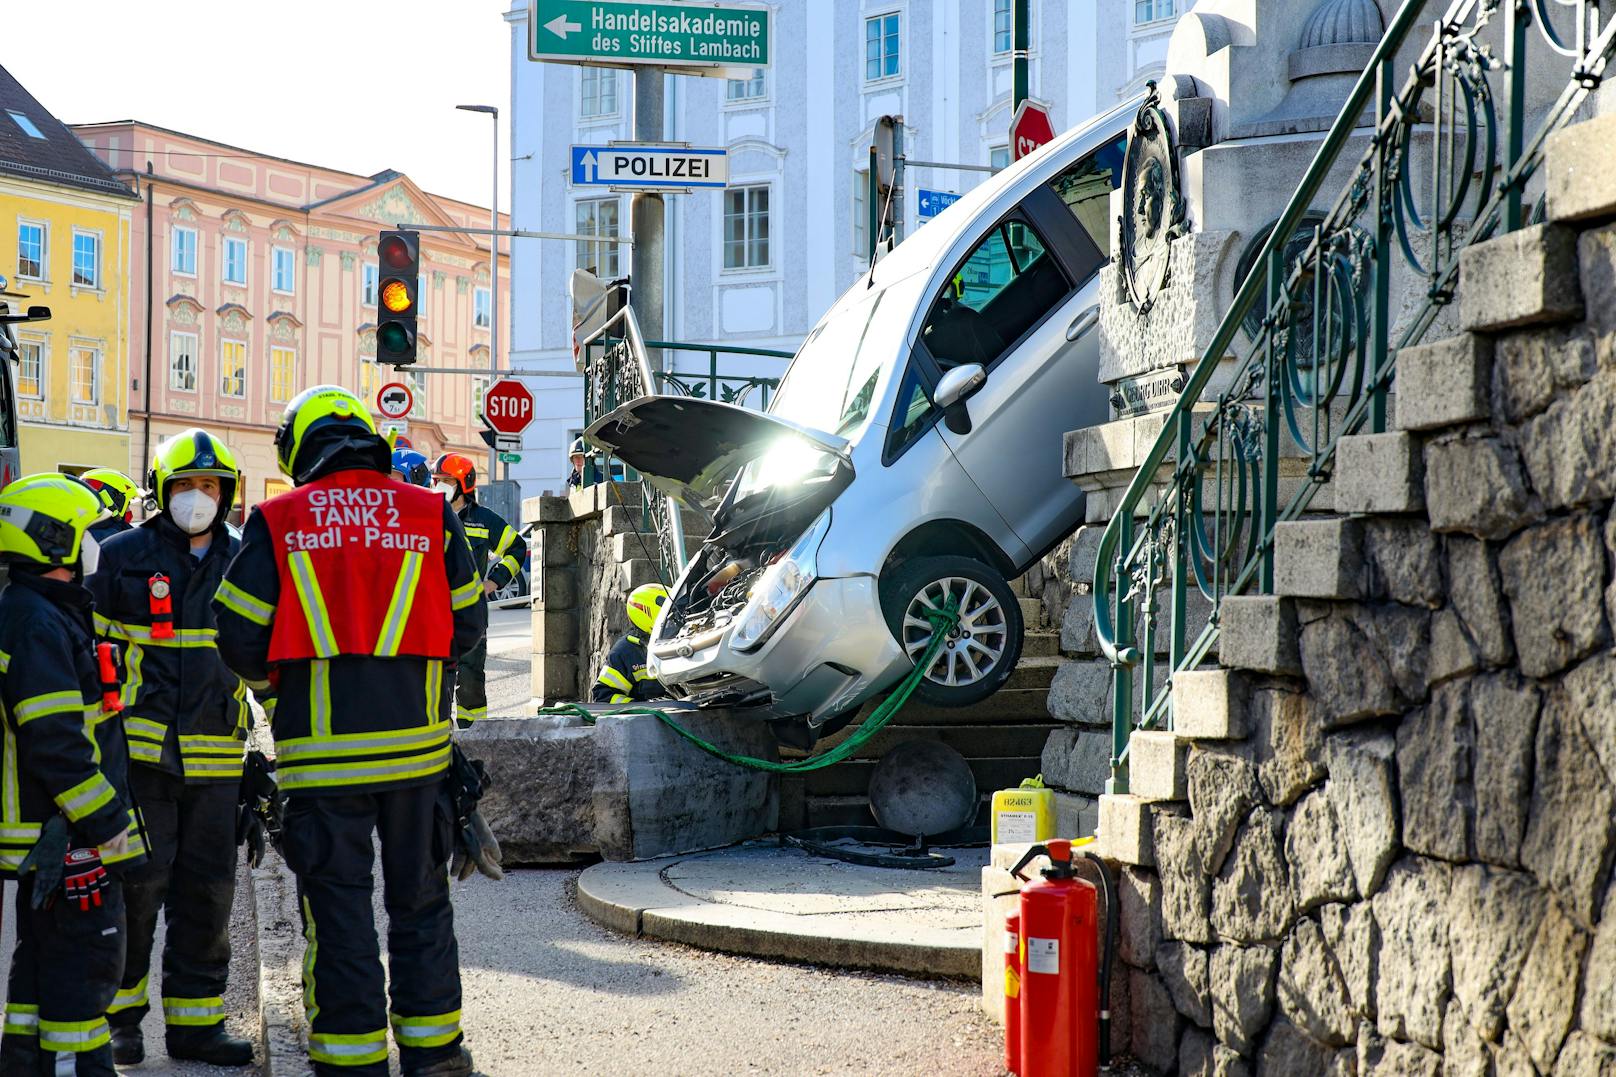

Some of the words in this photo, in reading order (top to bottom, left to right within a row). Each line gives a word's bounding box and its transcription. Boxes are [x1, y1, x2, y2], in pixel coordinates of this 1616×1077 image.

[591, 6, 761, 38] Handelsakademie
[592, 33, 621, 52] des
[629, 33, 682, 55] Stiftes
[690, 37, 760, 59] Lambach
[614, 156, 710, 178] POLIZEI
[490, 395, 530, 418] STOP
[308, 487, 397, 507] GRKDT
[309, 506, 380, 528] TANK
[385, 507, 401, 528] 2
[284, 526, 343, 552] Stadl
[364, 527, 431, 553] Paura
